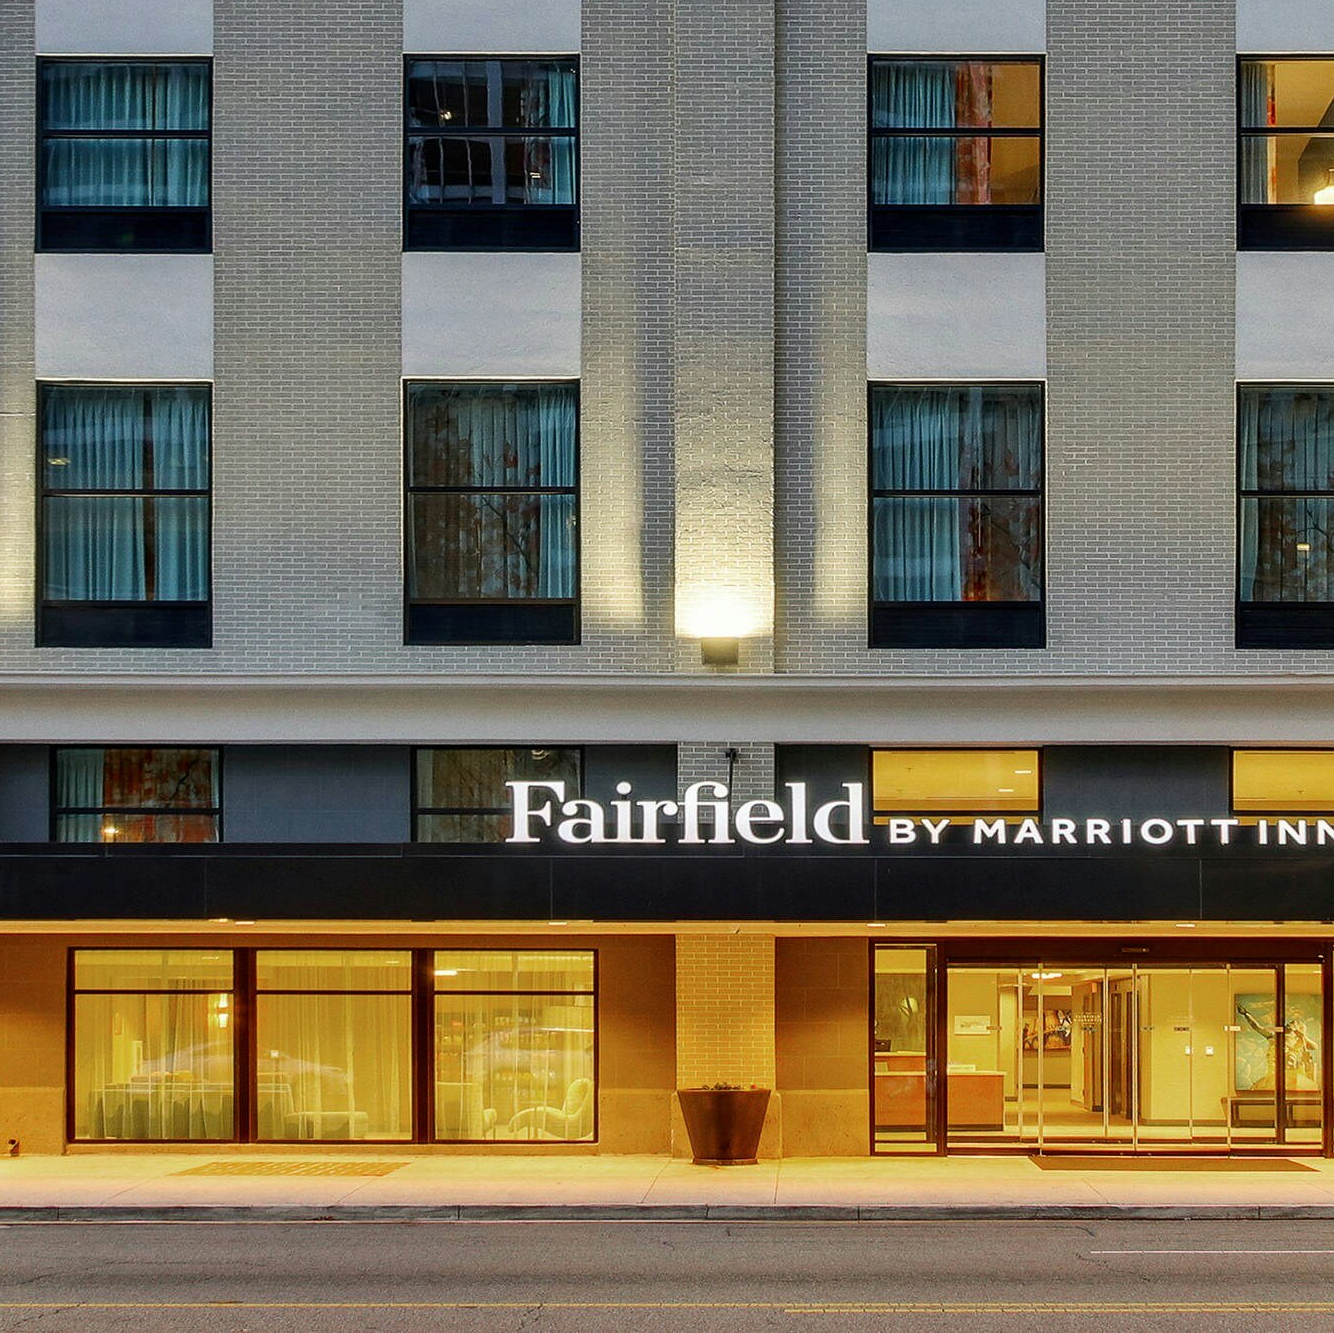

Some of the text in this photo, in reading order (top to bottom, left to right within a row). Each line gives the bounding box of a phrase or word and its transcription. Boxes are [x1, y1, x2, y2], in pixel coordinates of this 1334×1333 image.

[505, 780, 870, 845] Fairfield
[889, 818, 951, 845] BY
[973, 818, 1240, 846] MARRIOTT
